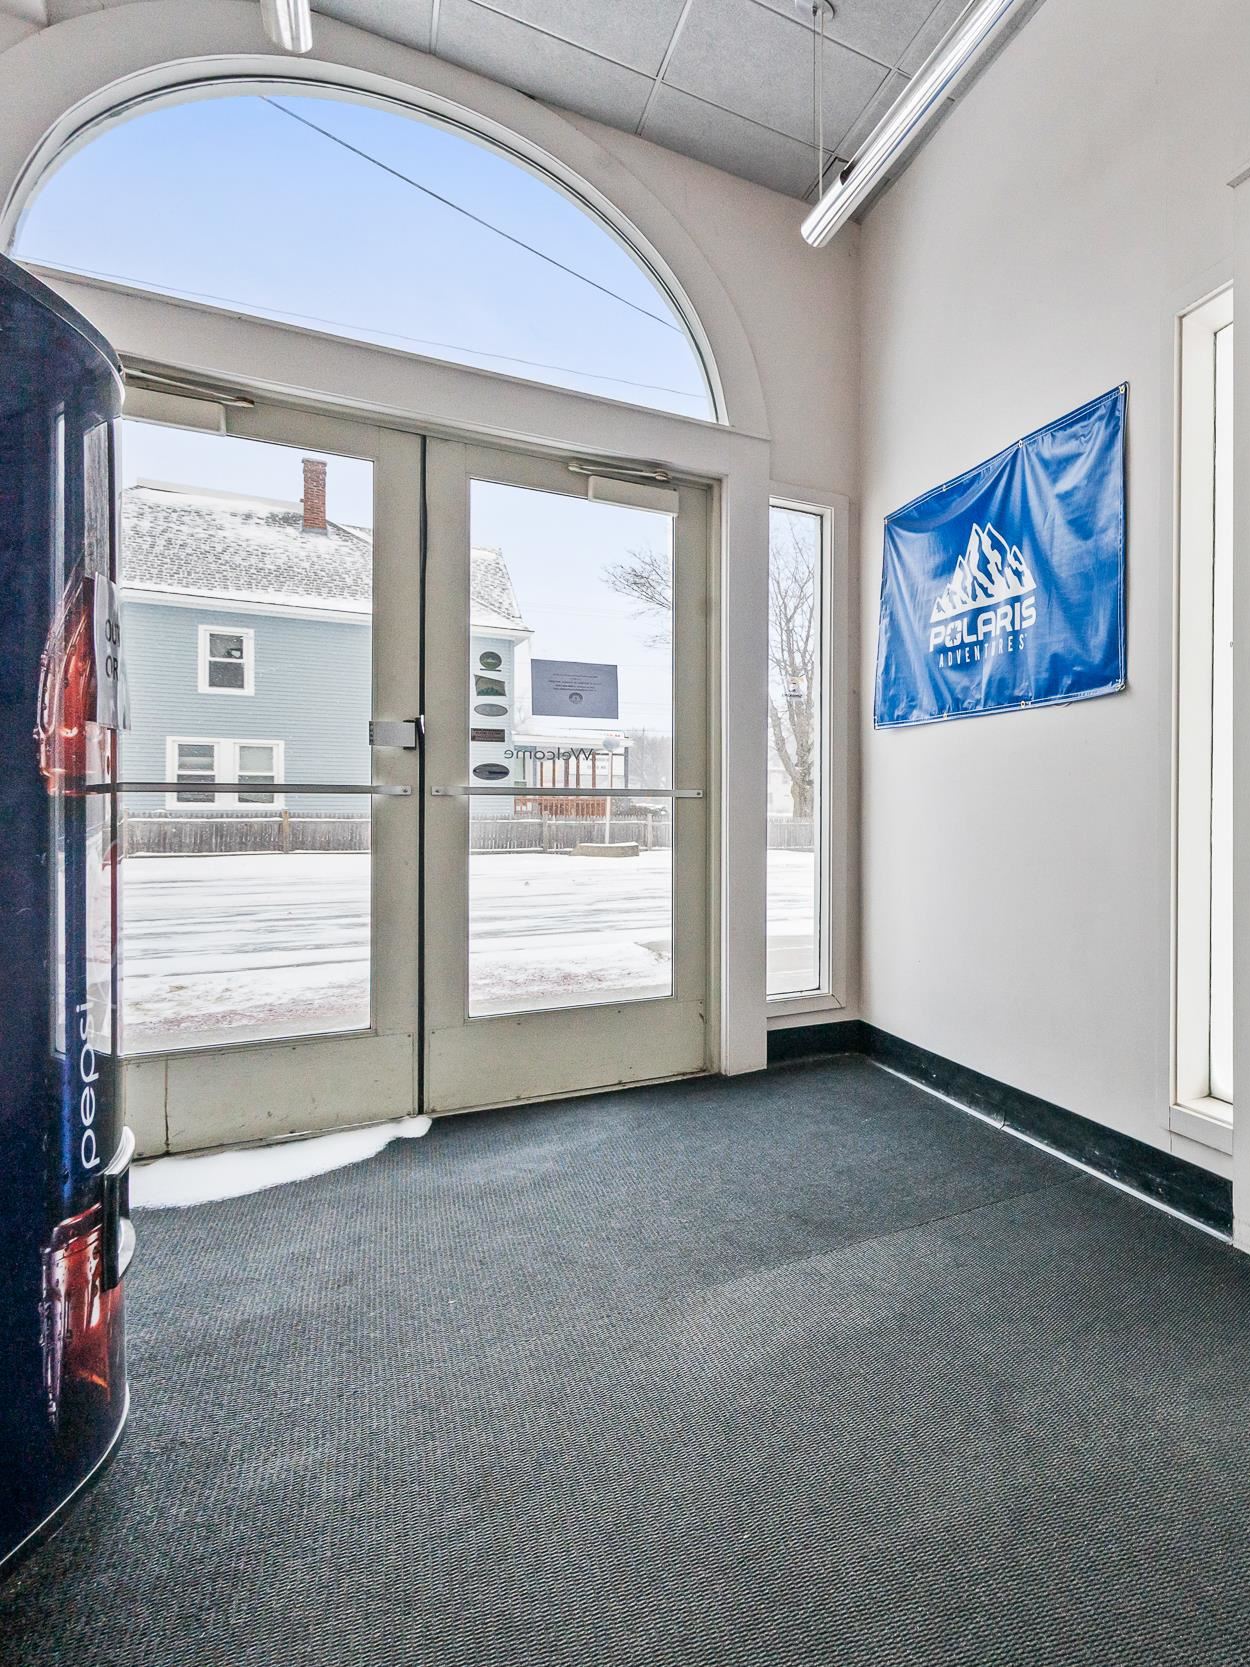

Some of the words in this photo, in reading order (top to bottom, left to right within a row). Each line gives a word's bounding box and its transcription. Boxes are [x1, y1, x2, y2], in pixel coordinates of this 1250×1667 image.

[929, 596, 1037, 652] POLARIS
[939, 634, 1025, 668] ADVENTURES
[76, 1002, 101, 1169] pepsi
